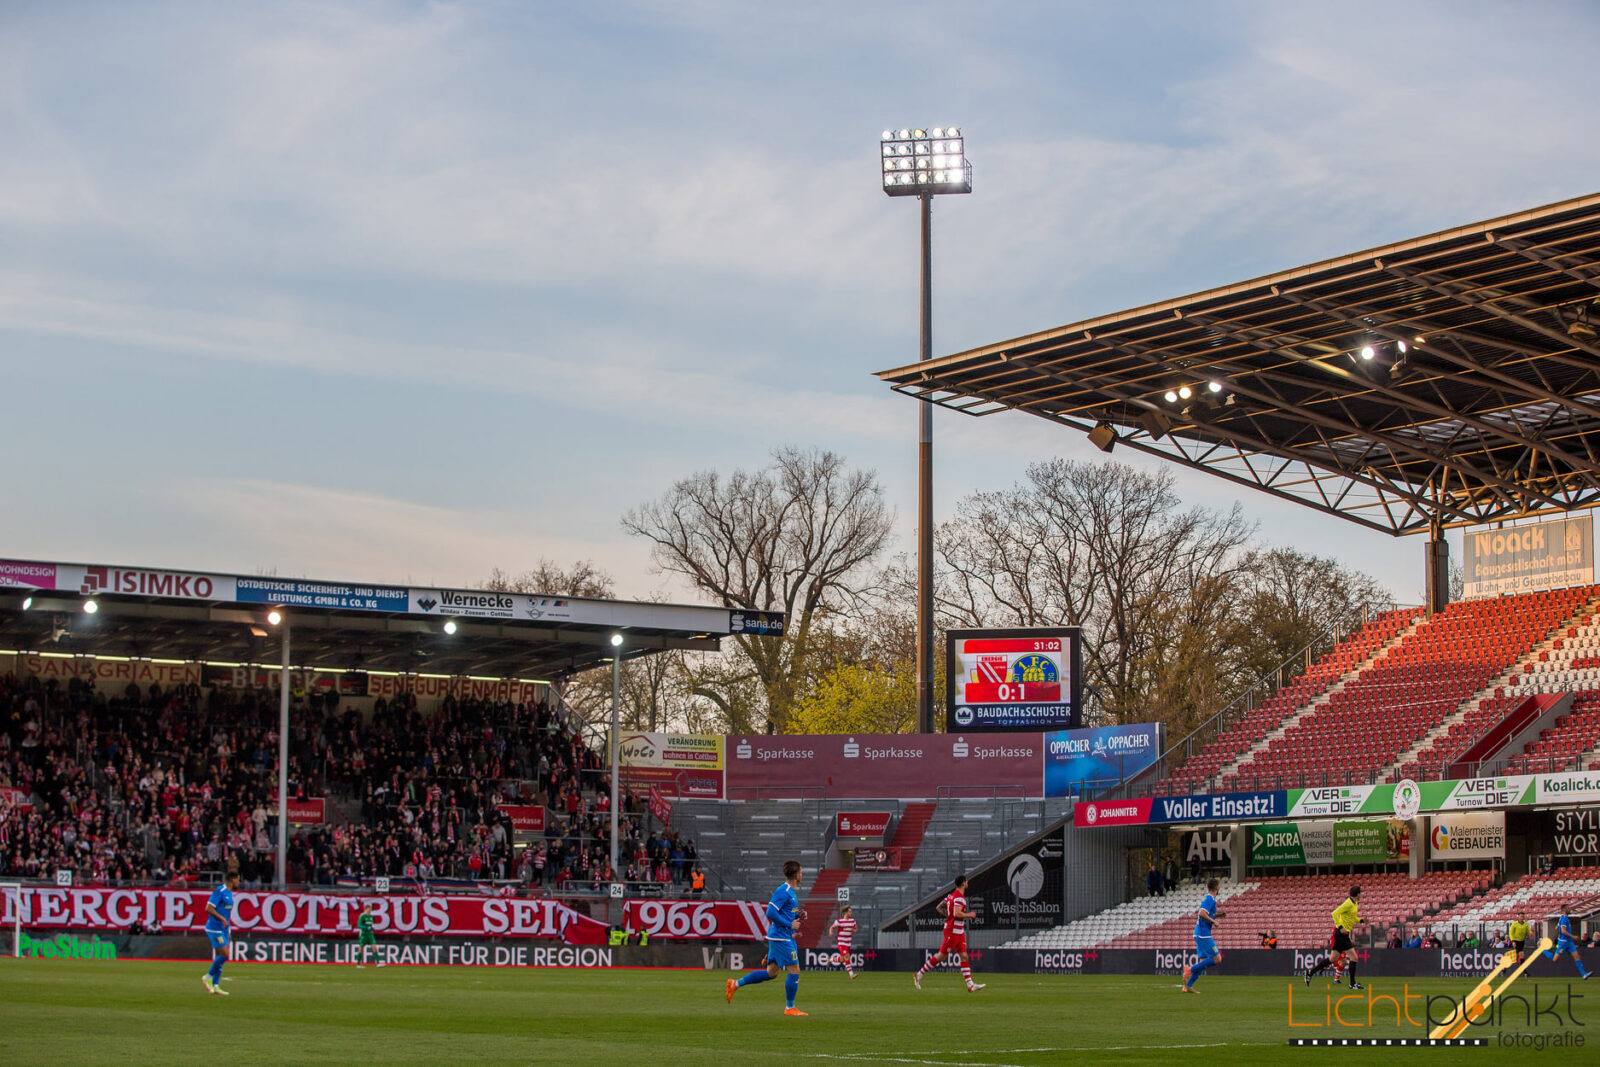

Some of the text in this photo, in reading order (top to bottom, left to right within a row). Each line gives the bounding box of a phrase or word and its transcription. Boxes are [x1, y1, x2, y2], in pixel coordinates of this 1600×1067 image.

[1475, 527, 1545, 558] Noack
[1475, 551, 1581, 577] Baugesellschaft mbH
[114, 570, 213, 598] ISIMKO
[1504, 579, 1520, 590] und
[1522, 572, 1581, 588] Gewerbebau
[237, 579, 408, 599] OSTDEUTSCHE SICHERHEITS- UND DIENST-
[268, 592, 377, 608] LEISTUNGS GMBH & CO. KG
[440, 591, 513, 608] Wernecke
[745, 619, 783, 630] sana.de
[1034, 641, 1060, 650] 31:02
[998, 683, 1025, 700] 0:1
[667, 736, 717, 747] VERÄNDERUNG
[1050, 738, 1090, 754] OPPACHER
[1108, 734, 1149, 749] OPPACHER
[757, 748, 814, 759] Sparkasse
[864, 747, 923, 758] Sparkasse
[974, 746, 1033, 758] Sparkasse
[1163, 794, 1274, 819] Voller Einsatz!
[1456, 798, 1482, 807] Turnow
[1099, 807, 1137, 818] JOHANNITER
[1303, 806, 1328, 814] Turnow
[1302, 830, 1332, 839] FAHRZEUGE
[1348, 829, 1363, 837] REWE
[1364, 828, 1379, 836] Markt
[1450, 824, 1504, 837] Malermeister
[1266, 831, 1300, 848] DEKRA
[1449, 837, 1501, 850] GEBAUER
[1306, 851, 1333, 859] INDUSTRIE
[59, 873, 70, 883] 22
[377, 879, 389, 889] 23
[611, 886, 622, 895] 24
[839, 889, 848, 899] 25
[231, 891, 450, 933] COTTBUS
[19, 934, 117, 959] ProStein
[255, 941, 327, 963] STEINE
[449, 941, 489, 966] FÜR
[495, 946, 527, 966] DIE
[534, 947, 612, 967] REGION
[1035, 949, 1083, 968] hectas
[1155, 949, 1199, 968] hecta
